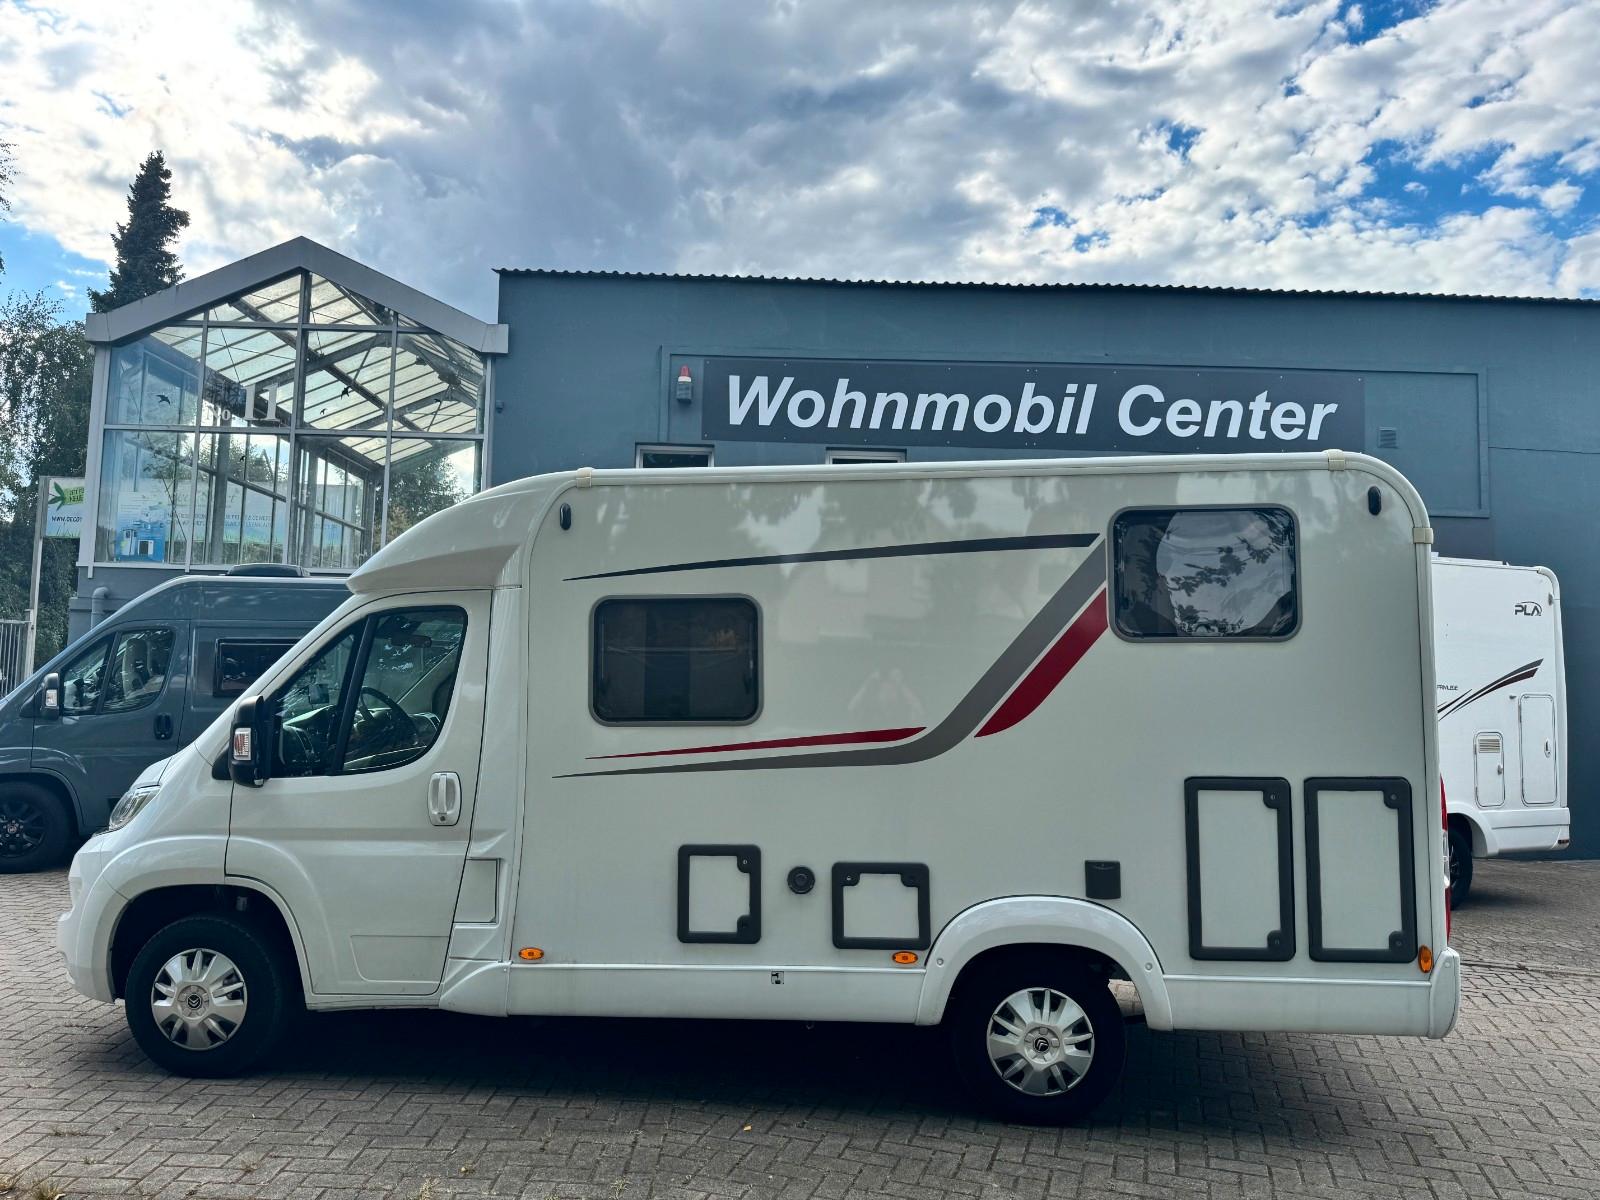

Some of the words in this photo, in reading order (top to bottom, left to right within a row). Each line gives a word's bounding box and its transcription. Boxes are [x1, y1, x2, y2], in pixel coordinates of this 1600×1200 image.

[241, 382, 281, 422] 11
[728, 375, 1098, 436] Wohnmobil
[1118, 384, 1338, 441] Center
[1514, 602, 1542, 617] PLA
